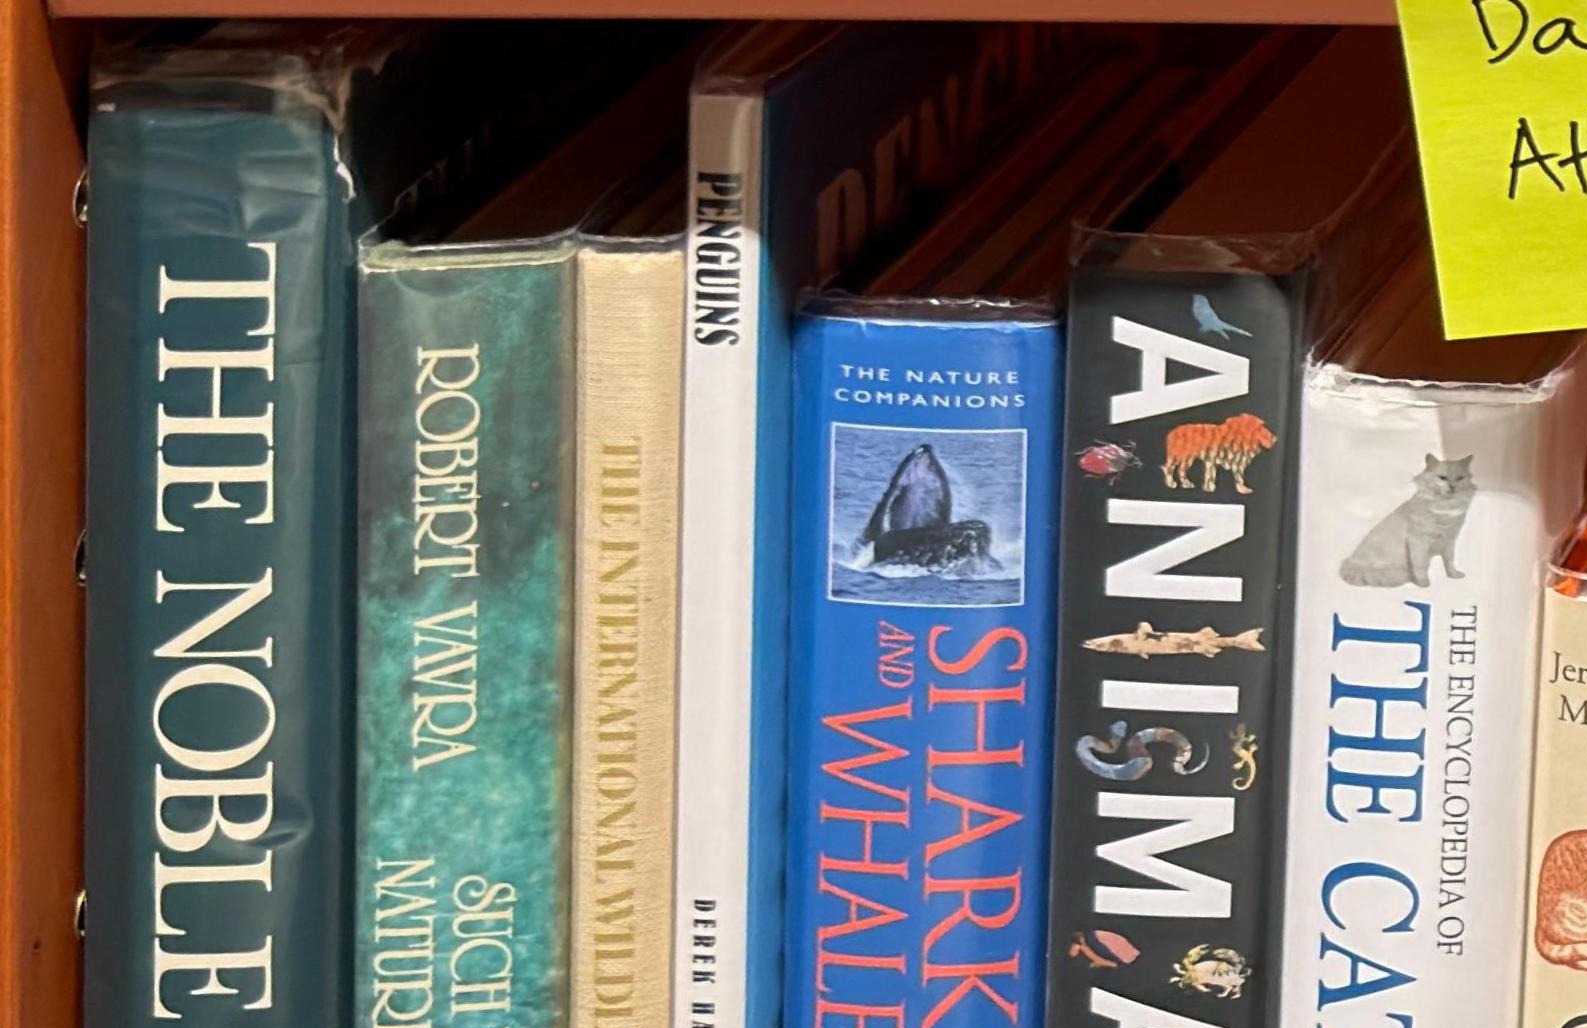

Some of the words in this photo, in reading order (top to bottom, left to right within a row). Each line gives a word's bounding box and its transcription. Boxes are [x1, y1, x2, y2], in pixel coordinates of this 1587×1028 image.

[692, 171, 746, 349] PENGUINS
[155, 241, 280, 534] THE
[833, 388, 1027, 409] COMPANIONS
[840, 363, 892, 385] THE
[906, 367, 1020, 386] NATURE
[413, 343, 480, 578] ROBERT
[601, 435, 643, 528] THE
[410, 599, 478, 772] VAVRA
[593, 539, 641, 885] INTERNATIONAL
[876, 620, 916, 688] AND
[1324, 599, 1434, 825] THE
[1447, 605, 1477, 667] THE
[152, 569, 277, 1020] NOBLE
[1436, 675, 1474, 910] ENCYCLOPEDIA
[450, 874, 518, 1015] SUCH
[690, 898, 717, 985] DEREK
[1434, 918, 1464, 958] OF
